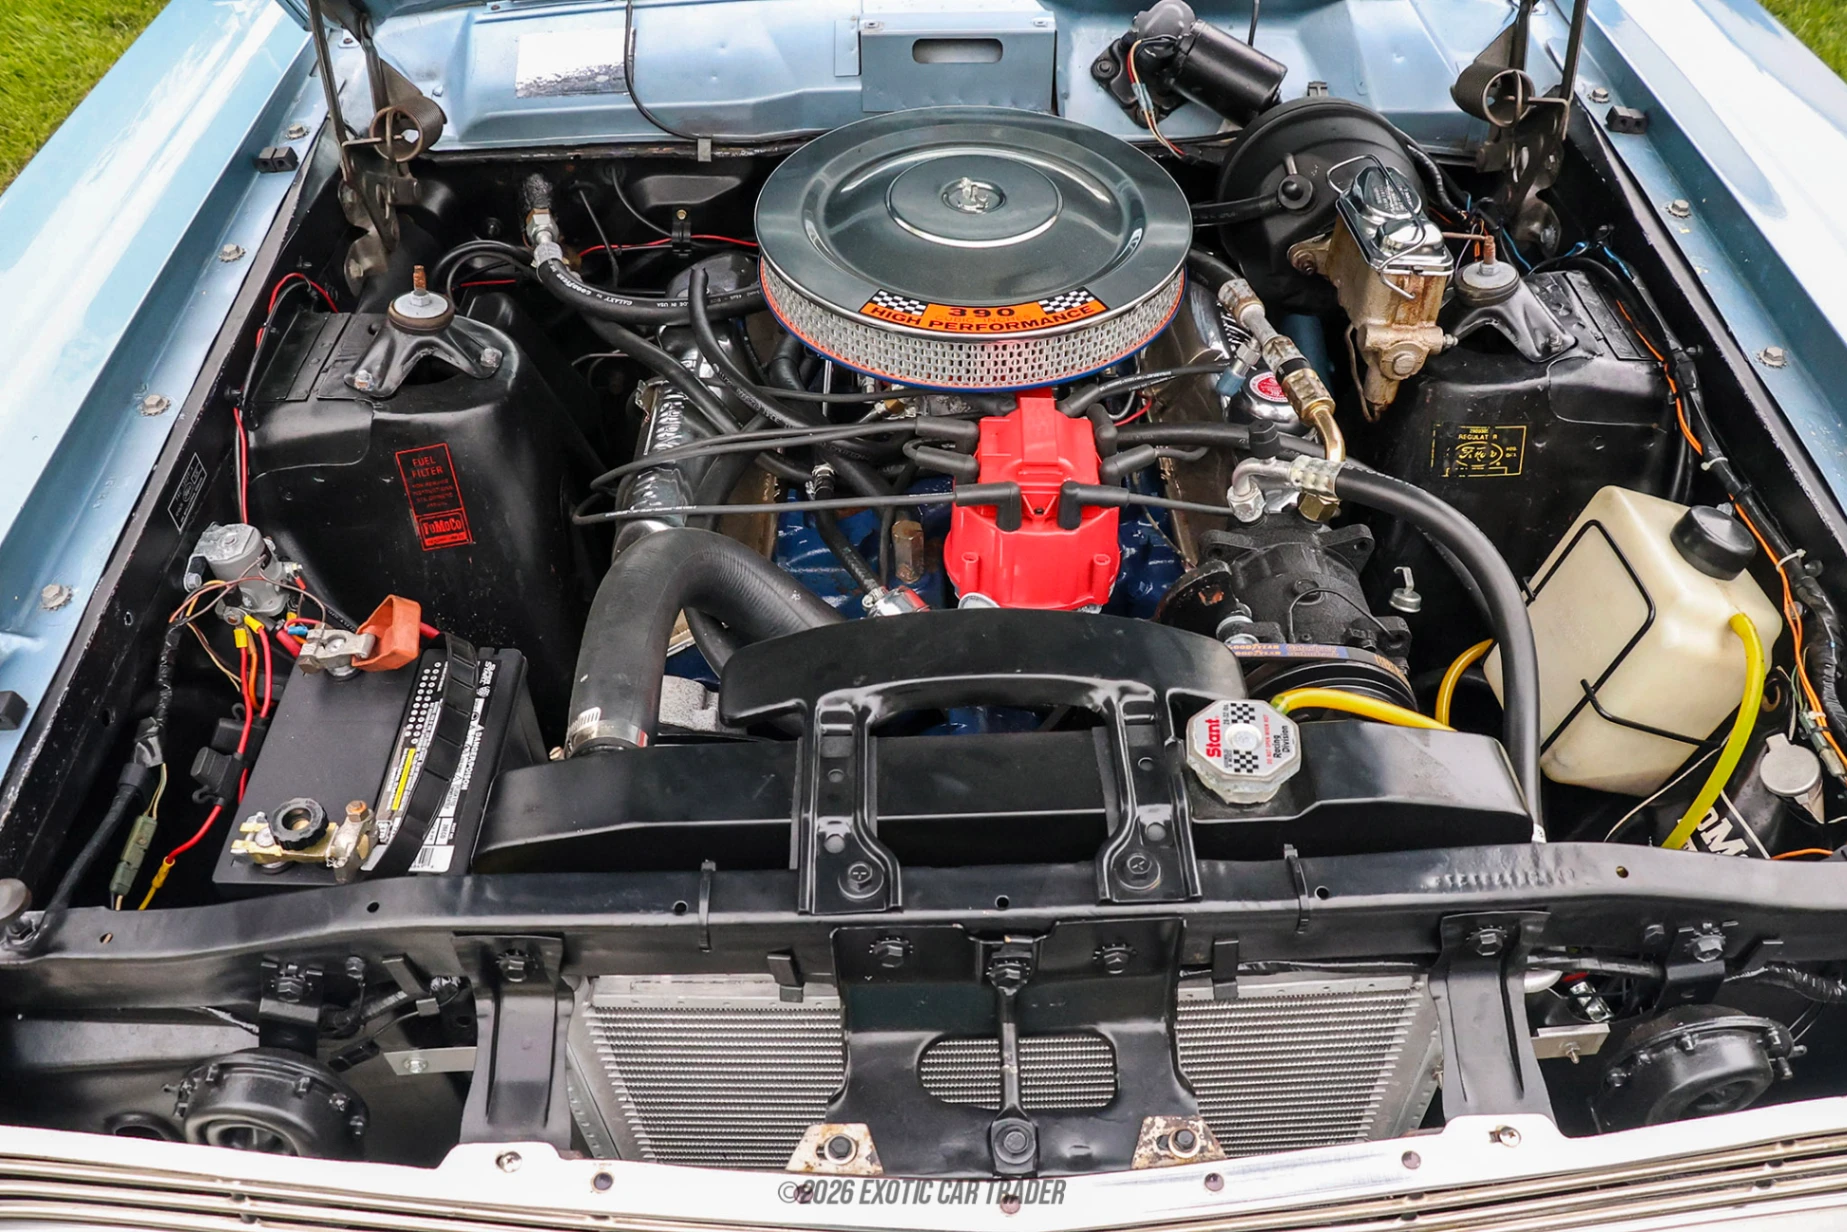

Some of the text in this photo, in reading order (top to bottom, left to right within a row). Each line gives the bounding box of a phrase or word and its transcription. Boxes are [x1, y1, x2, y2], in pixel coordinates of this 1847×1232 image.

[556, 273, 592, 296] GOODYEAR
[604, 296, 633, 306] GALAXY
[871, 305, 1095, 331] HIGH PERFORMANCE
[935, 314, 1032, 323] CUBIC INCHES
[948, 307, 1015, 317] 390
[1458, 433, 1498, 441] REGULATR
[412, 456, 436, 467] FUEL
[412, 465, 444, 478] FILTER
[1205, 718, 1222, 758] Stant
[1281, 725, 1290, 753] Division
[1272, 735, 1282, 759] Racing
